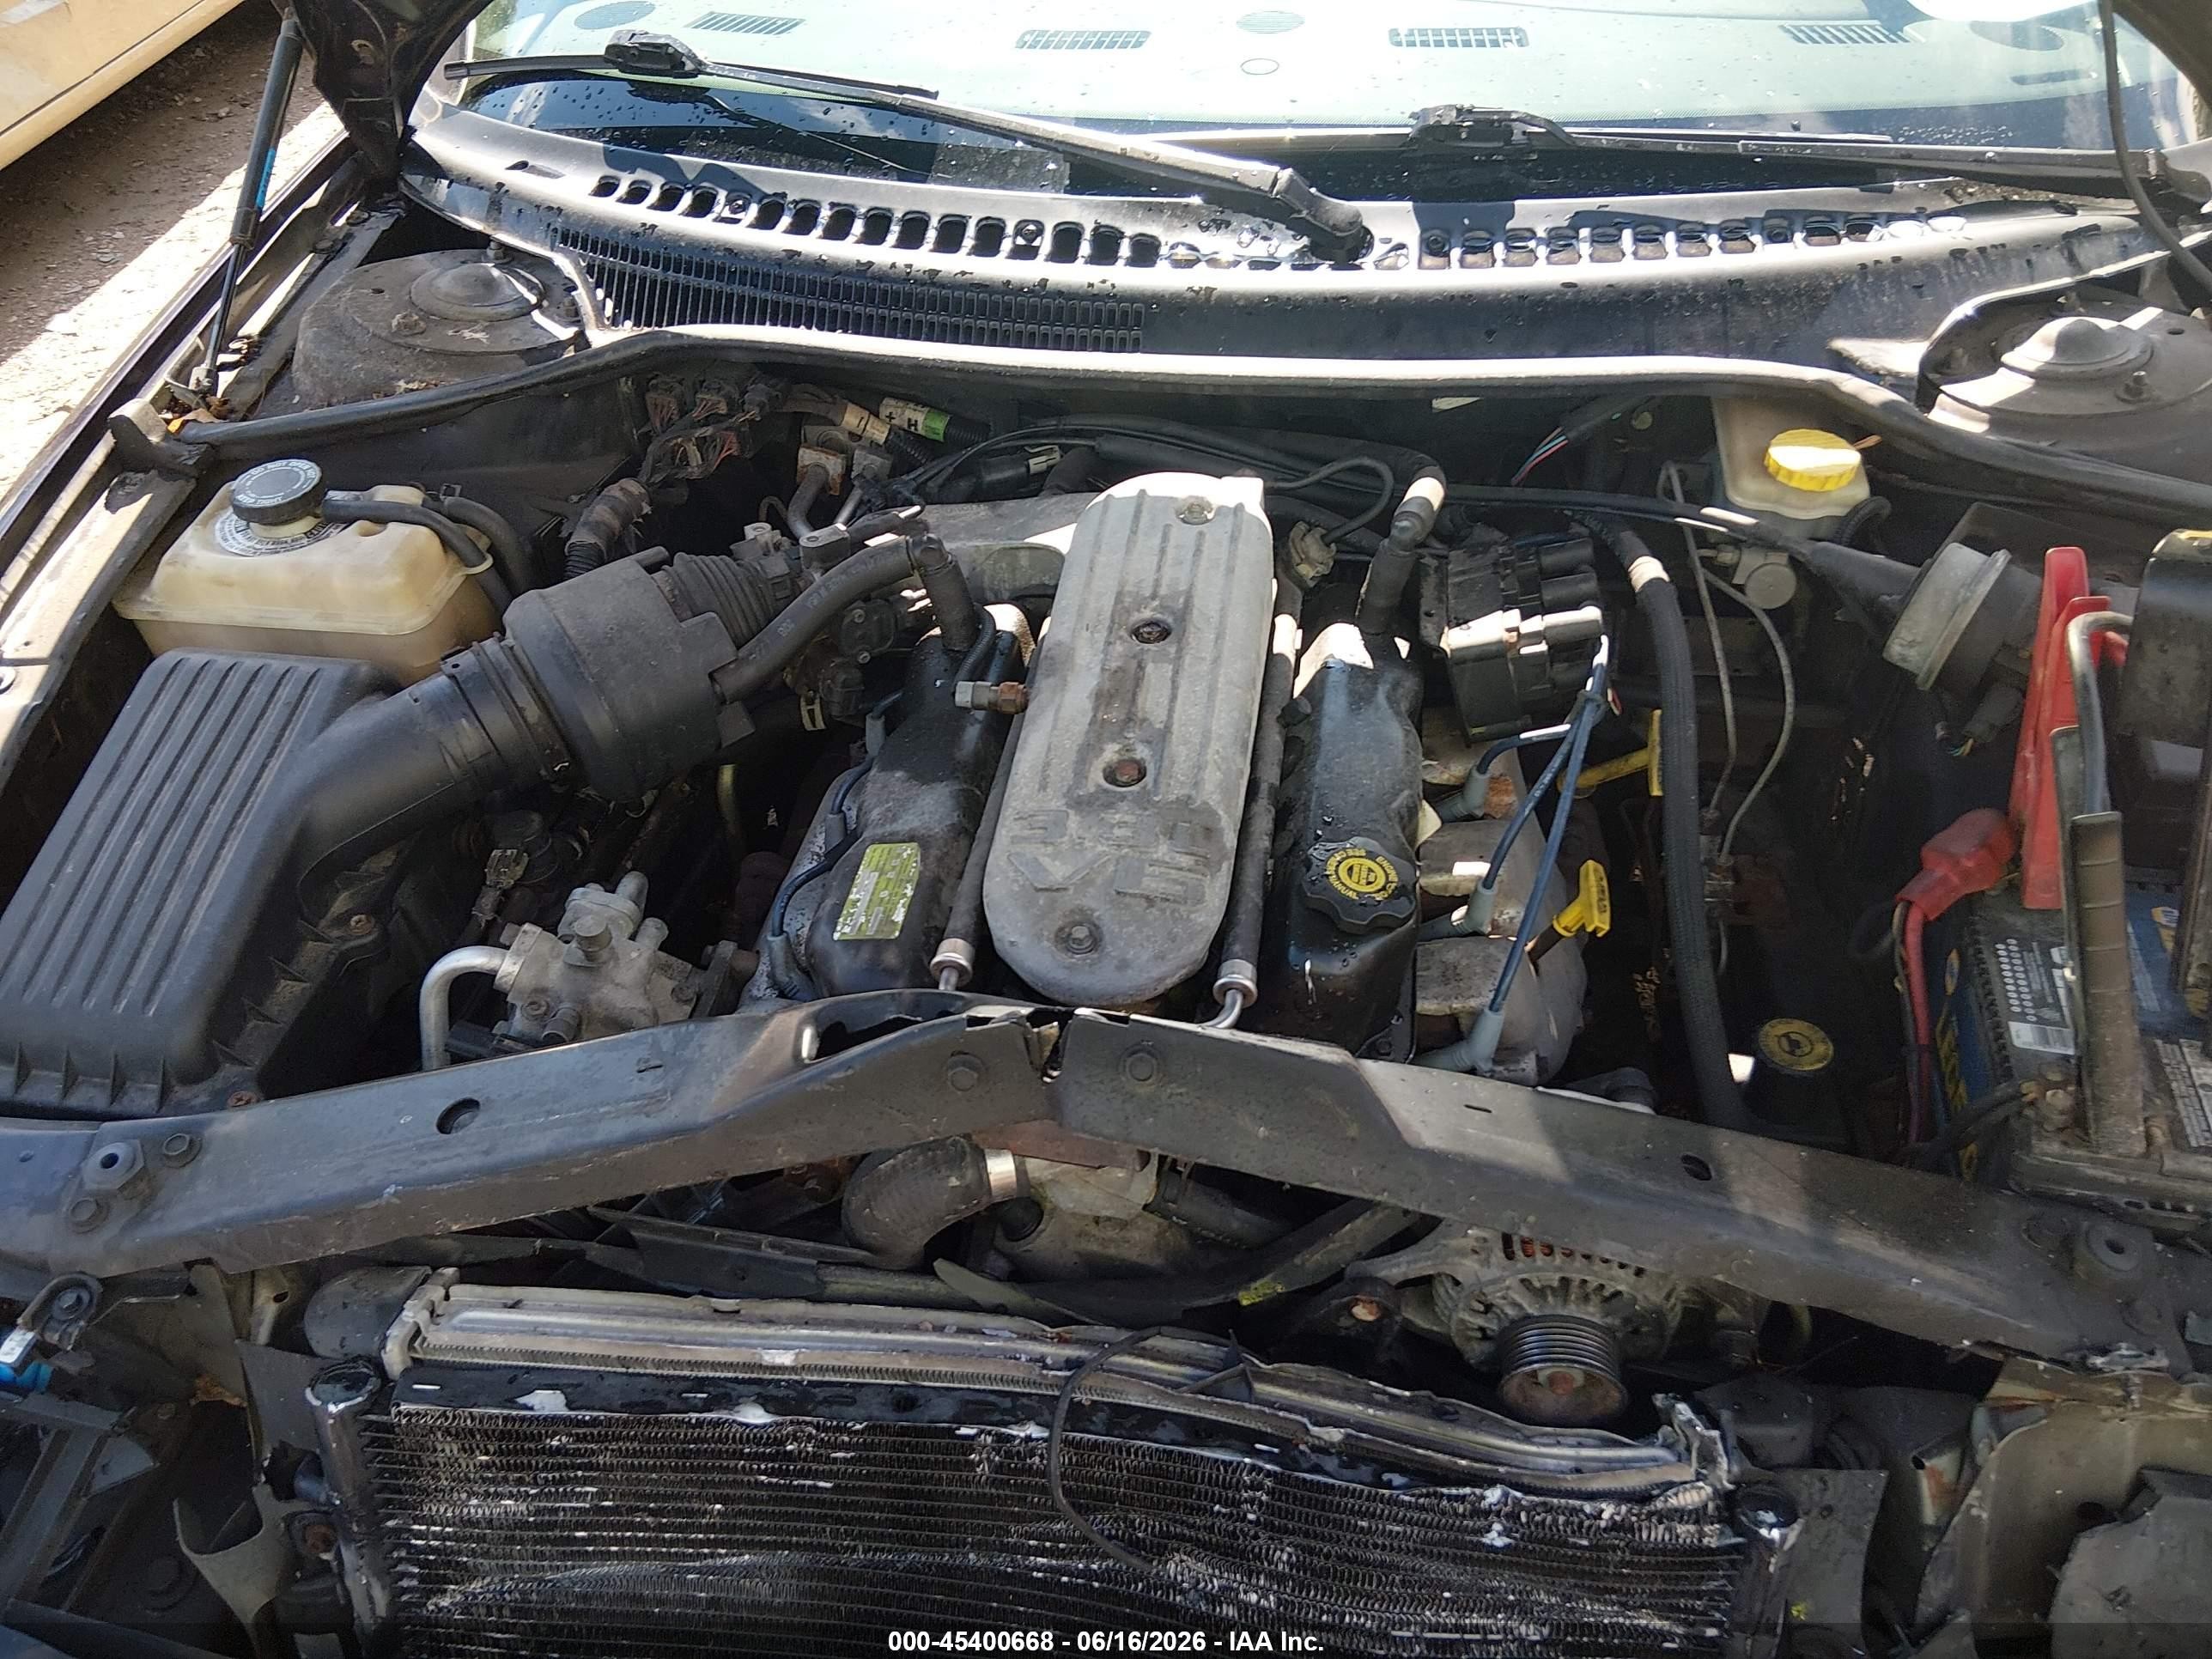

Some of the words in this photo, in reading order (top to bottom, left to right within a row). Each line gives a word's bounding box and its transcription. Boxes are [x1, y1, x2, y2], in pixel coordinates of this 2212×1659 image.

[251, 467, 265, 476] DO
[289, 461, 311, 471] OPEN
[235, 494, 256, 503] KEEP
[1006, 851, 1210, 906] V6
[1376, 855, 1399, 882] ENGINE
[1328, 874, 1359, 900] MANUAL
